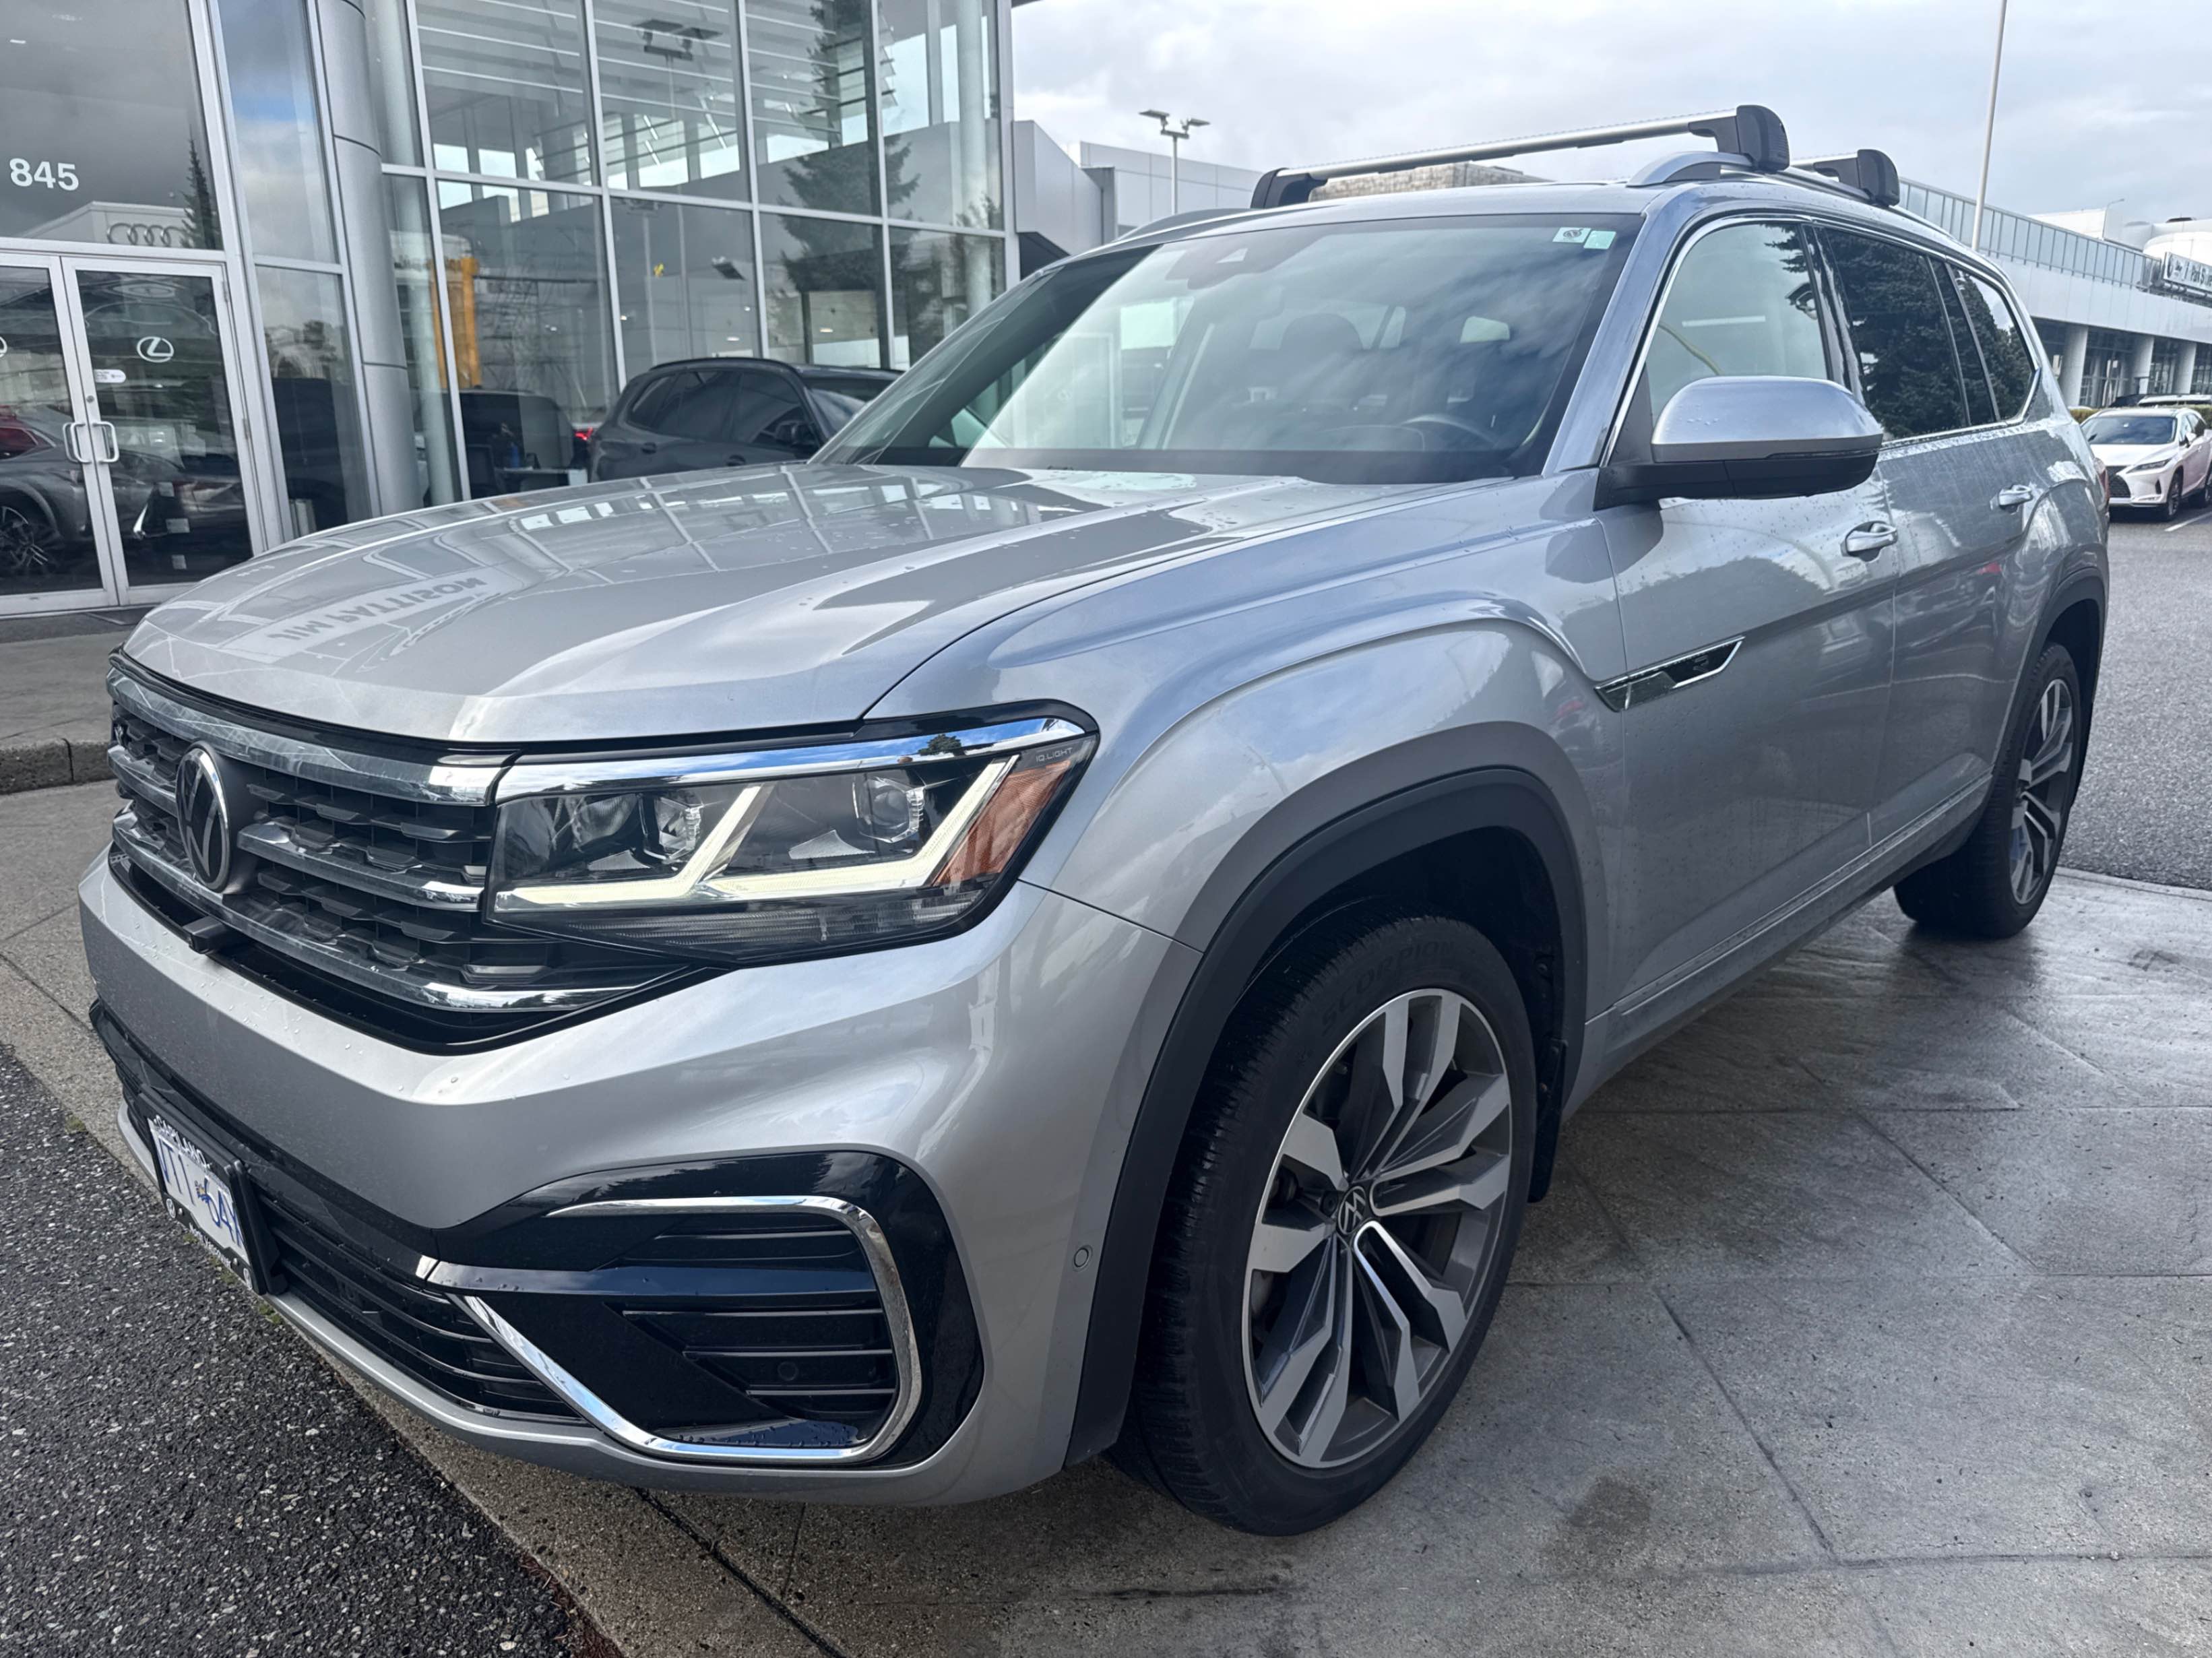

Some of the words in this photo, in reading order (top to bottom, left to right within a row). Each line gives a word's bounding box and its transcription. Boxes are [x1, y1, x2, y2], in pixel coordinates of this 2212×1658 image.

[9, 158, 79, 191] 845
[1035, 746, 1073, 762] IQ.LIGHT
[1321, 940, 1456, 1038] SCORPION
